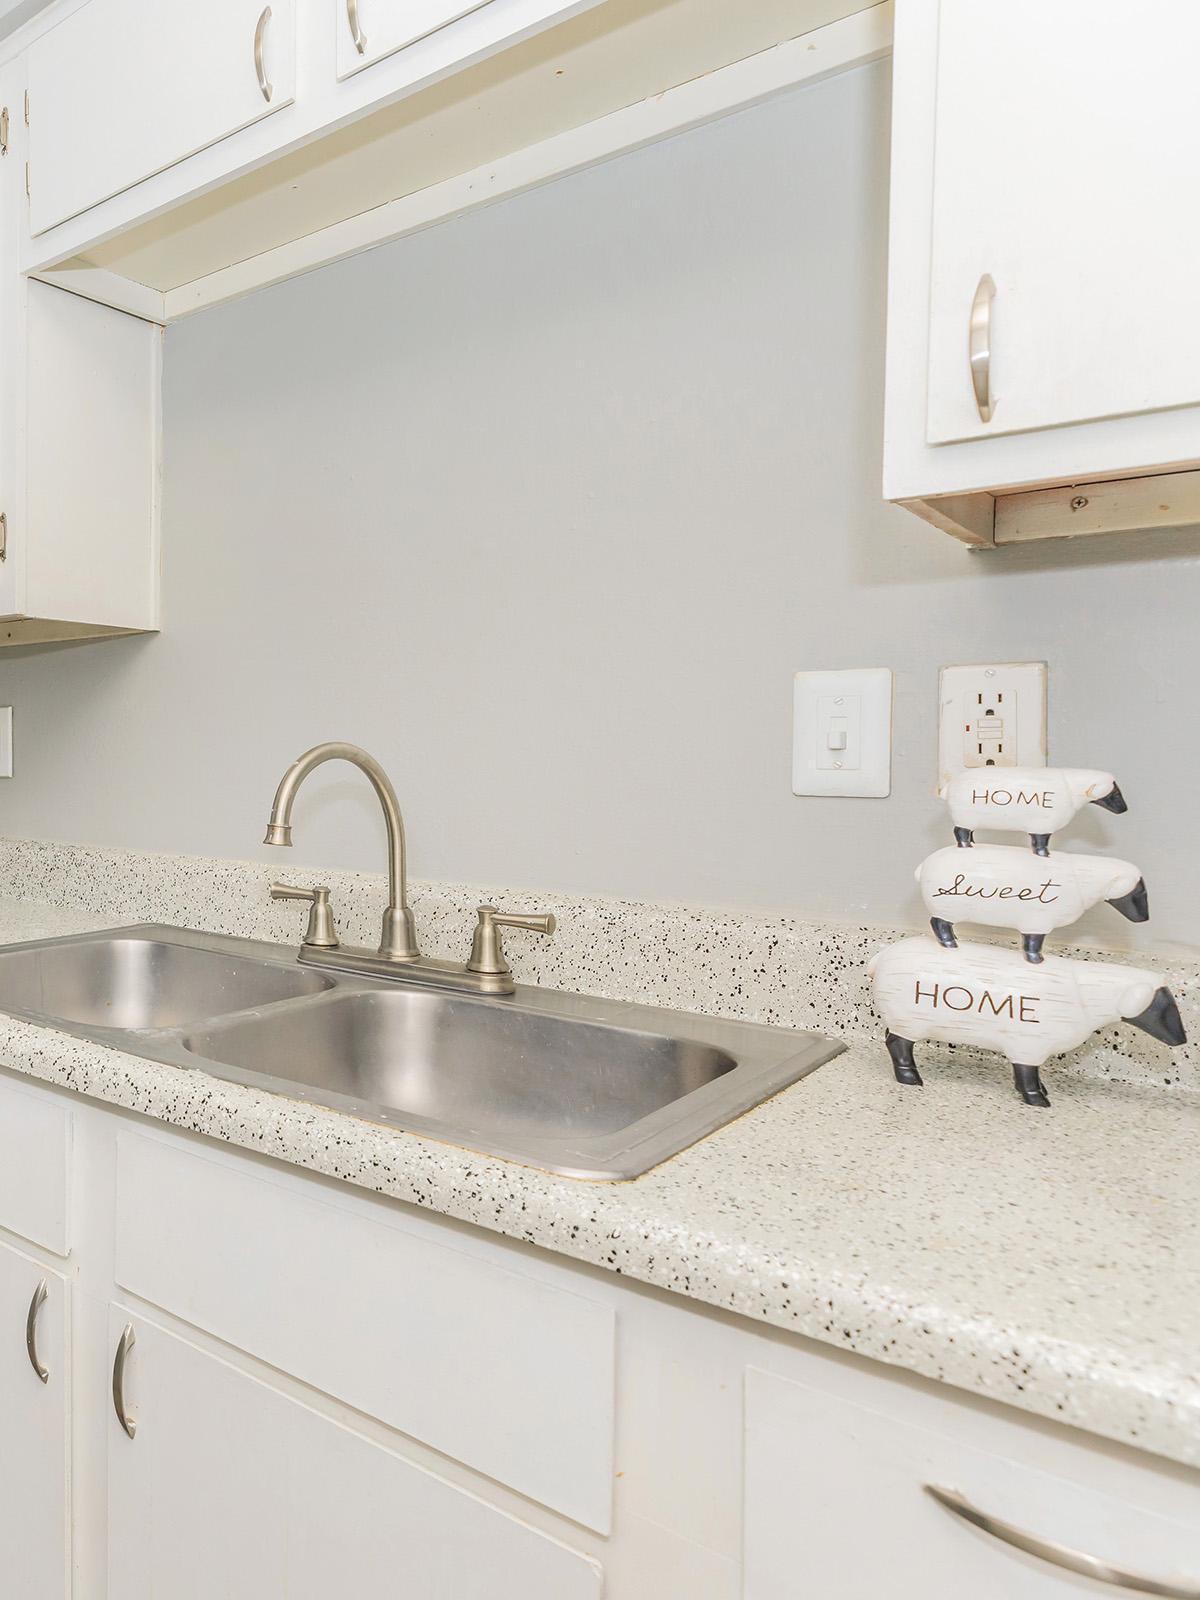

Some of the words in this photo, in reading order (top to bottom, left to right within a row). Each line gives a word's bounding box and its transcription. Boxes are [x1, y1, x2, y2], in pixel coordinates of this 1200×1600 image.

[972, 789, 1055, 809] HOME
[932, 874, 1062, 904] Sweet
[915, 980, 1041, 1024] HOME
